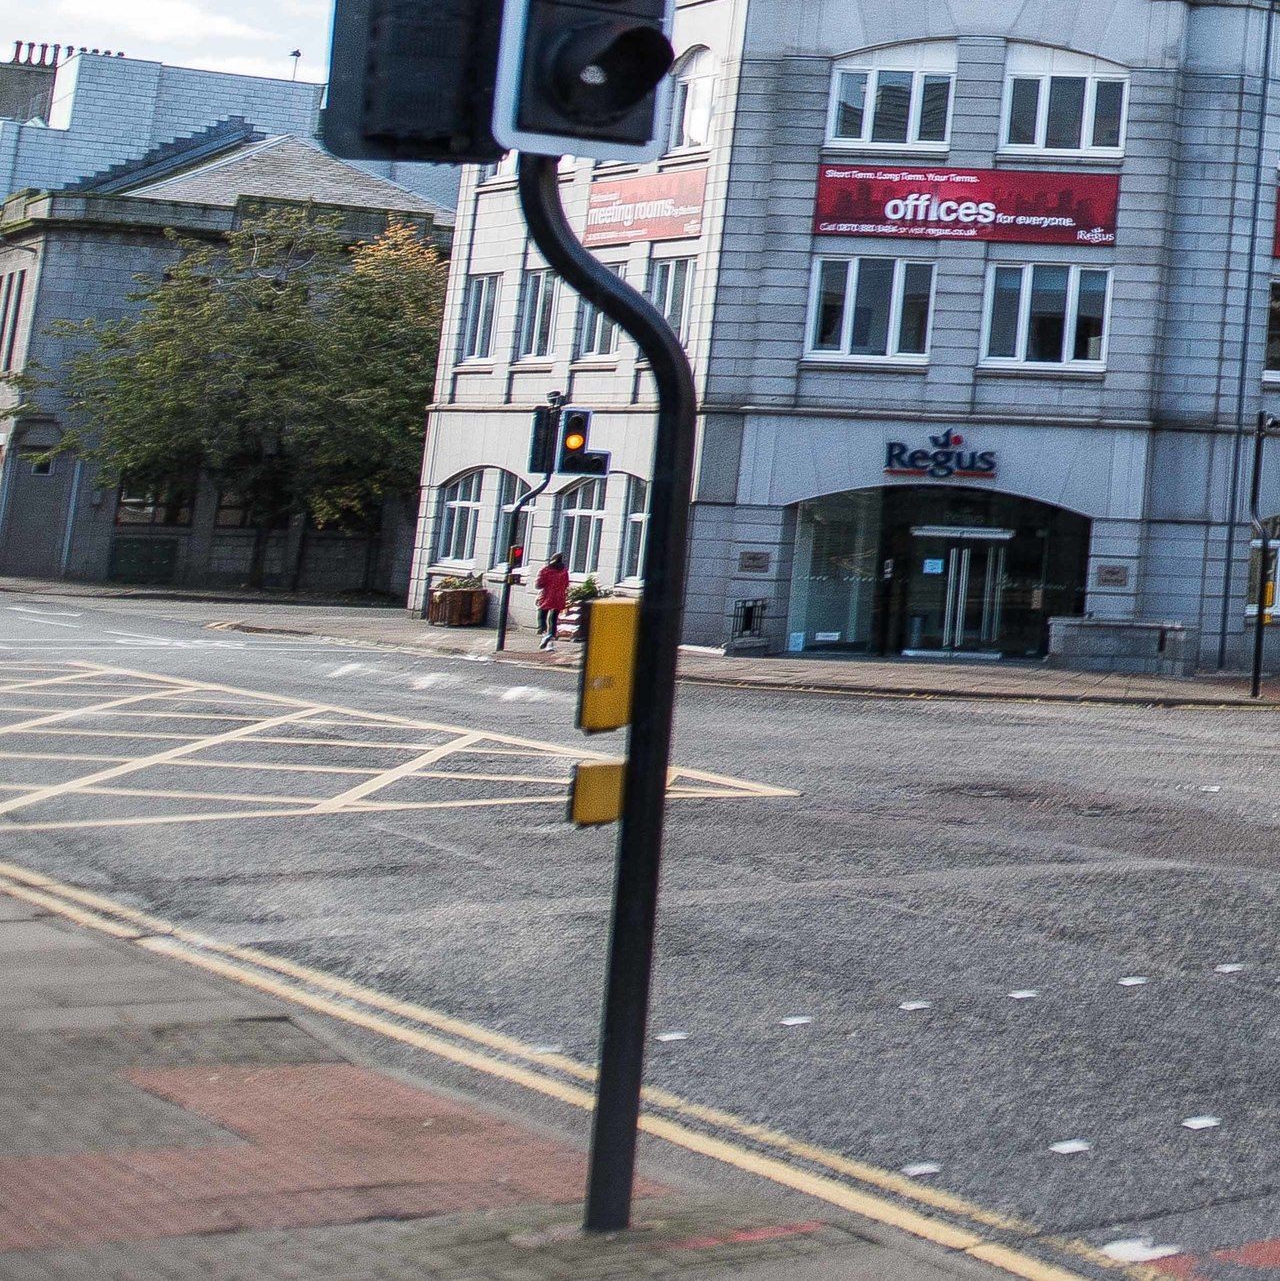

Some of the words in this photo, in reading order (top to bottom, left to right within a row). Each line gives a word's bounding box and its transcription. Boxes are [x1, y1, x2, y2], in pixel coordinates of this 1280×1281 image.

[588, 200, 634, 226] meeting
[635, 199, 675, 219] rooms
[884, 193, 996, 223] offices
[996, 212, 1015, 224] for
[1016, 214, 1077, 227] everyone.
[1077, 228, 1115, 243] Regus
[884, 442, 997, 478] Regus
